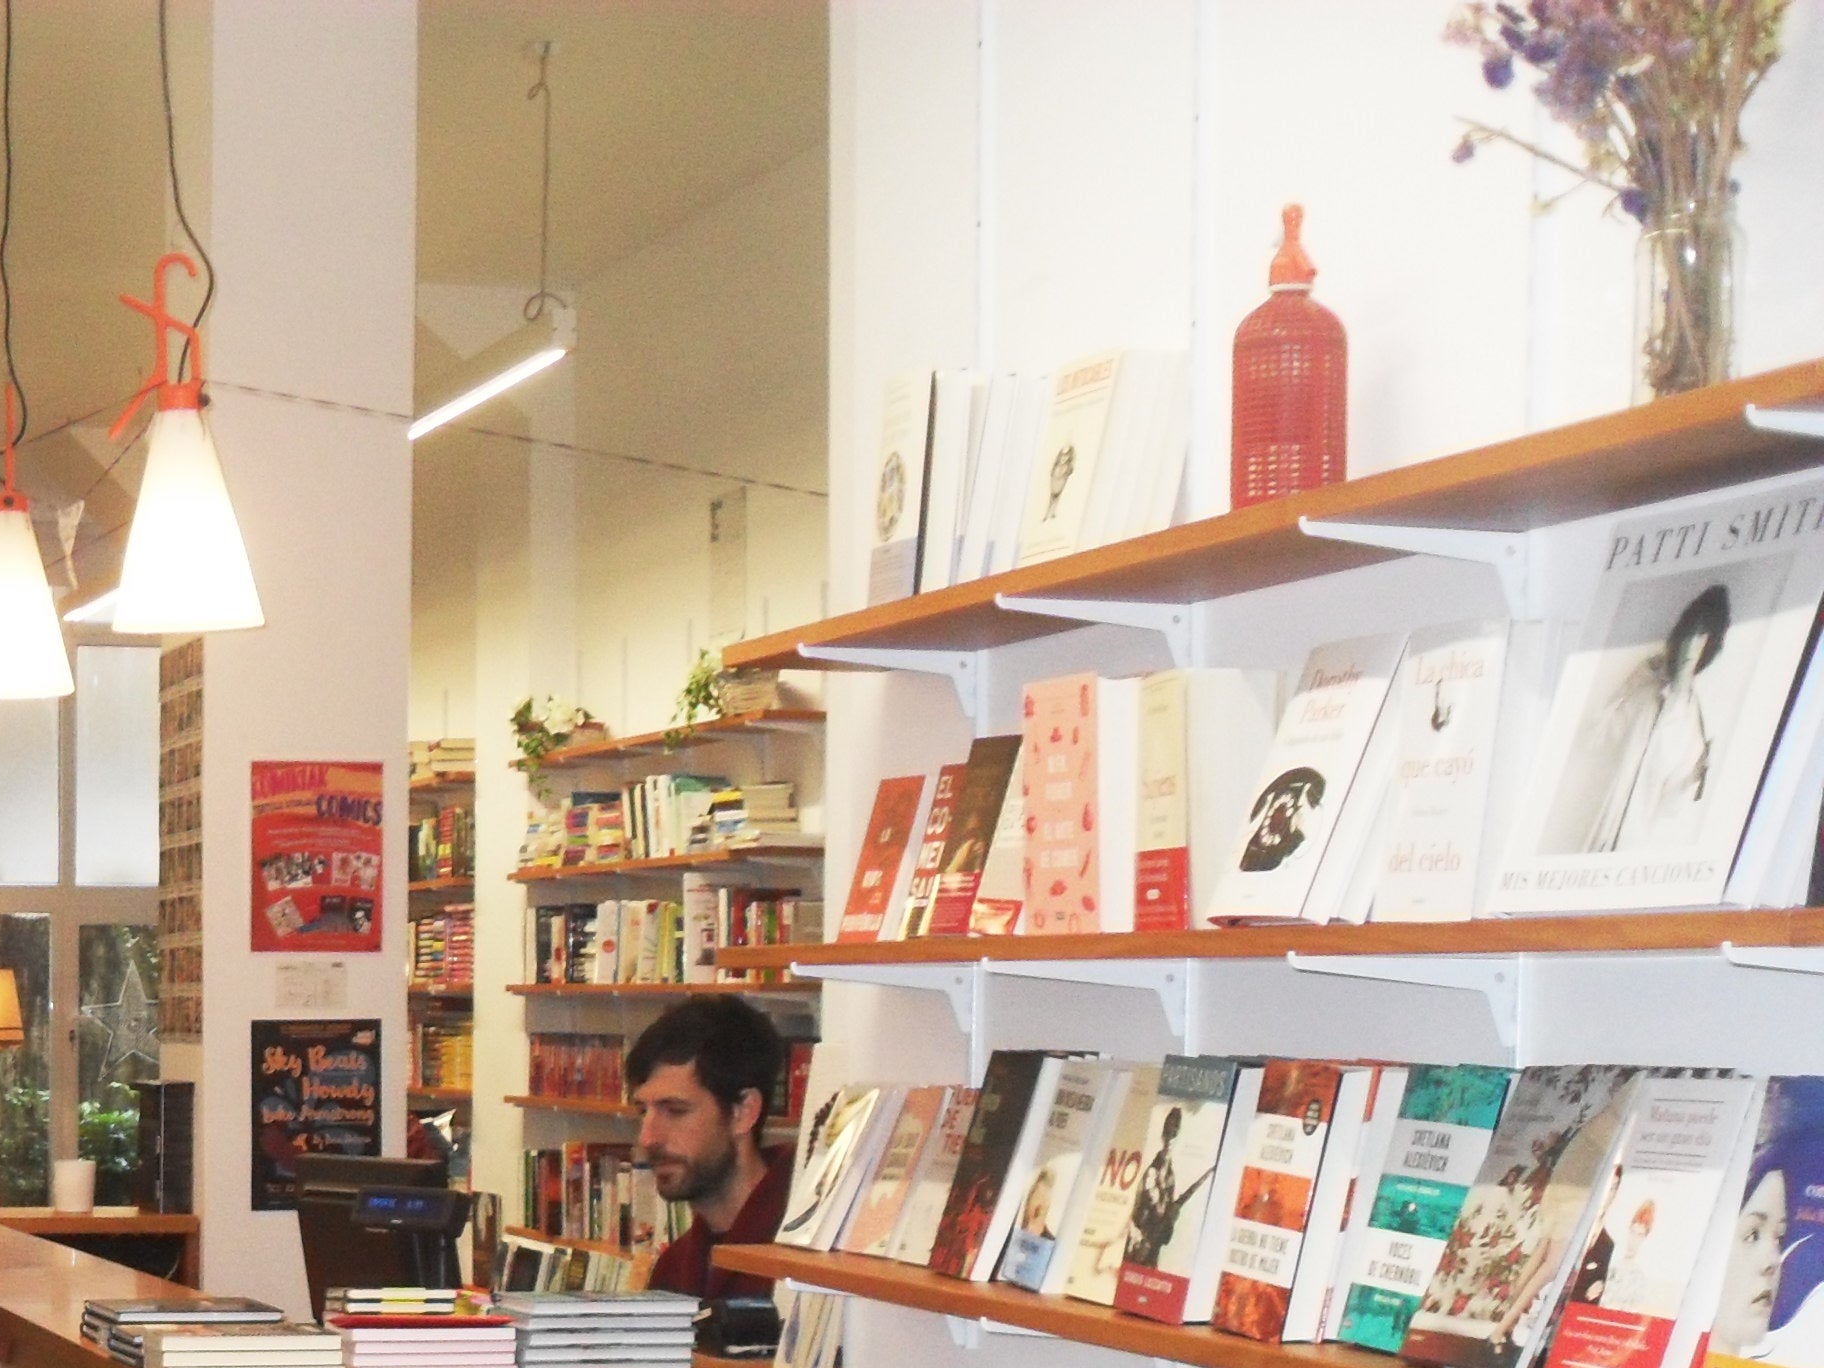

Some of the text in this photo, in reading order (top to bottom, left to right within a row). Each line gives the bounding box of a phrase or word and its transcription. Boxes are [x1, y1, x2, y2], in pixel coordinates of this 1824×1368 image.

[1606, 498, 1824, 571] PATTI SMIT
[316, 794, 382, 826] COMICS
[1388, 839, 1463, 872] del cielo
[1501, 860, 1717, 892] MIS MEJORES CANCIONES
[1099, 1149, 1142, 1191] NO
